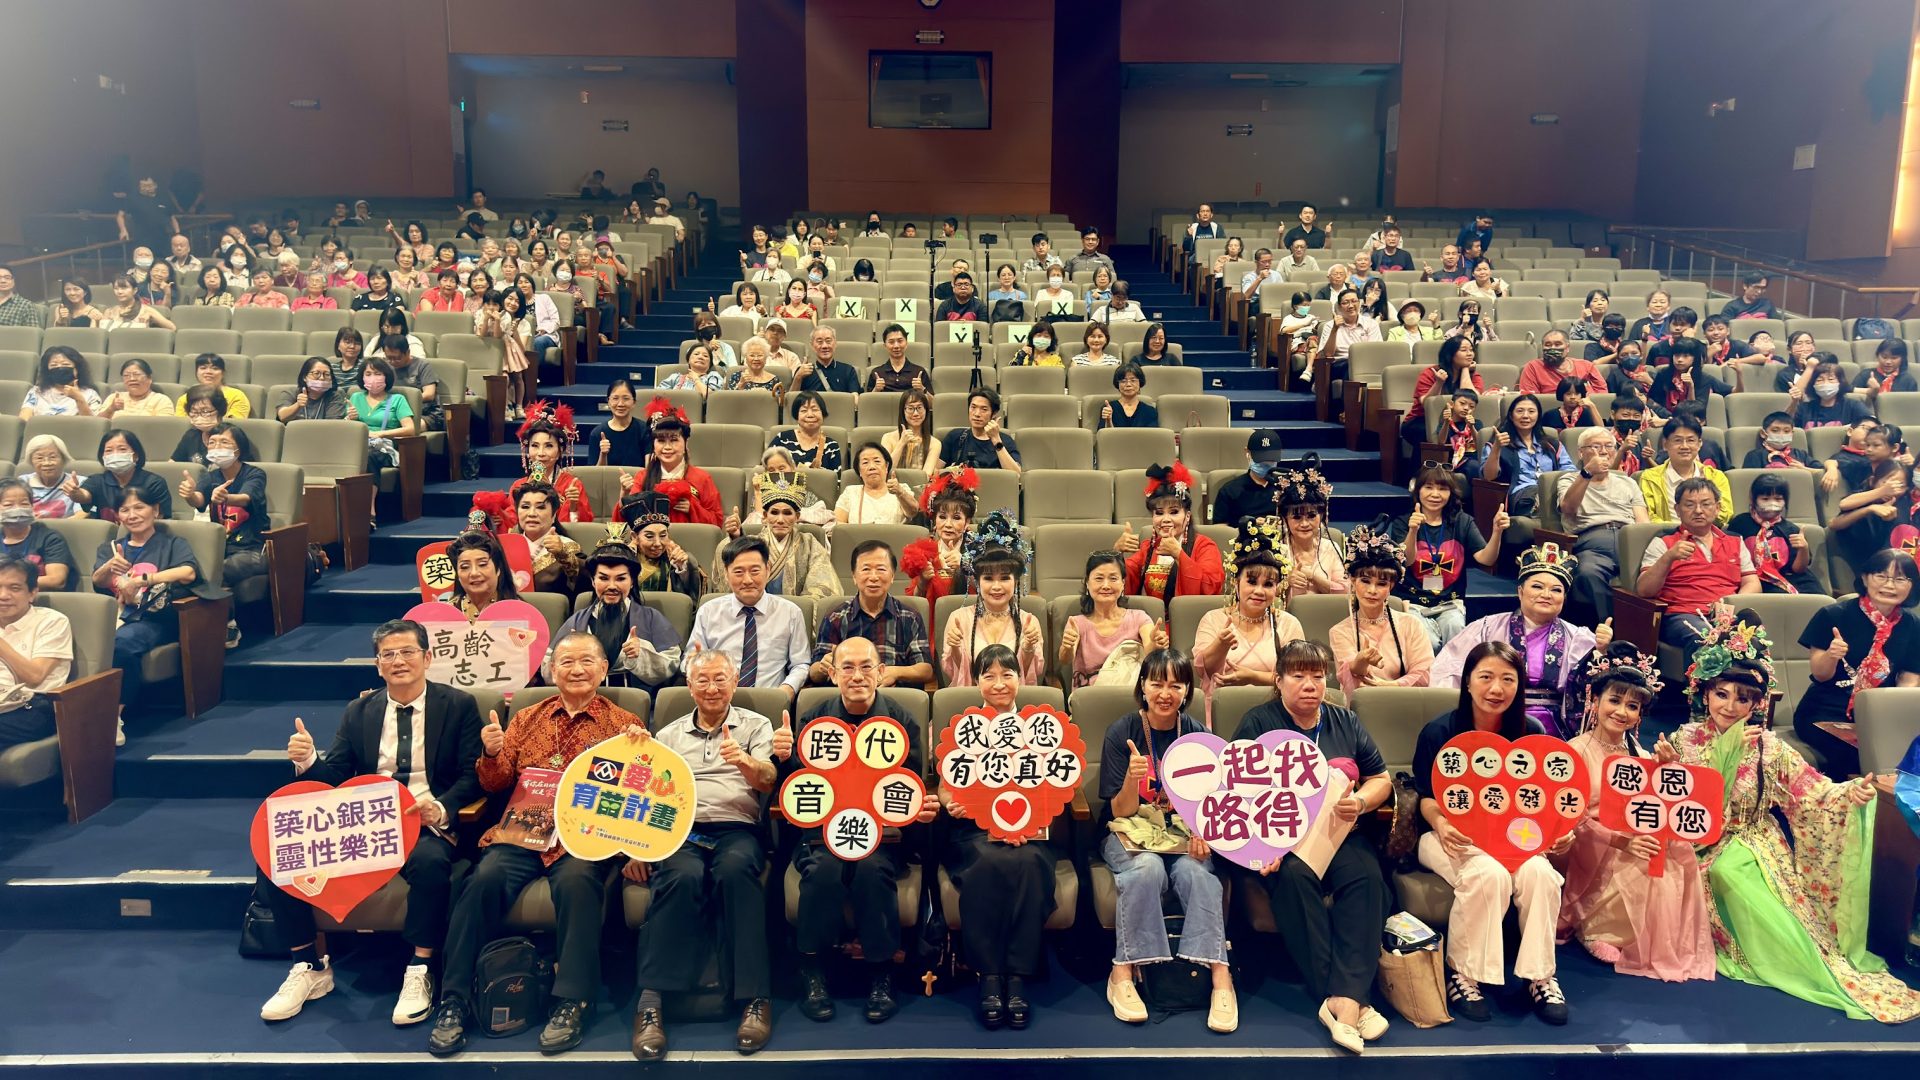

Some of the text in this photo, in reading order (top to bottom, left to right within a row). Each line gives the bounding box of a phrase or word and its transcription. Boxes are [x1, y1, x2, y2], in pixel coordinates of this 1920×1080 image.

[900, 299, 912, 313] X
[432, 629, 495, 659] 高齡
[450, 658, 511, 686] 志工
[809, 728, 896, 763] 跨代
[958, 714, 1058, 749] 我愛您
[621, 758, 676, 798] 愛心
[949, 751, 1077, 786] 有您真好
[1171, 741, 1322, 790] 一起找
[1442, 751, 1568, 778] 築心之家
[1610, 763, 1689, 796] 感恩
[274, 795, 397, 839] 築心銀采
[1202, 791, 1302, 842] 路得
[1446, 787, 1579, 813] 讓愛發光
[1630, 800, 1707, 834] 有您
[275, 828, 399, 873] 靈性樂活
